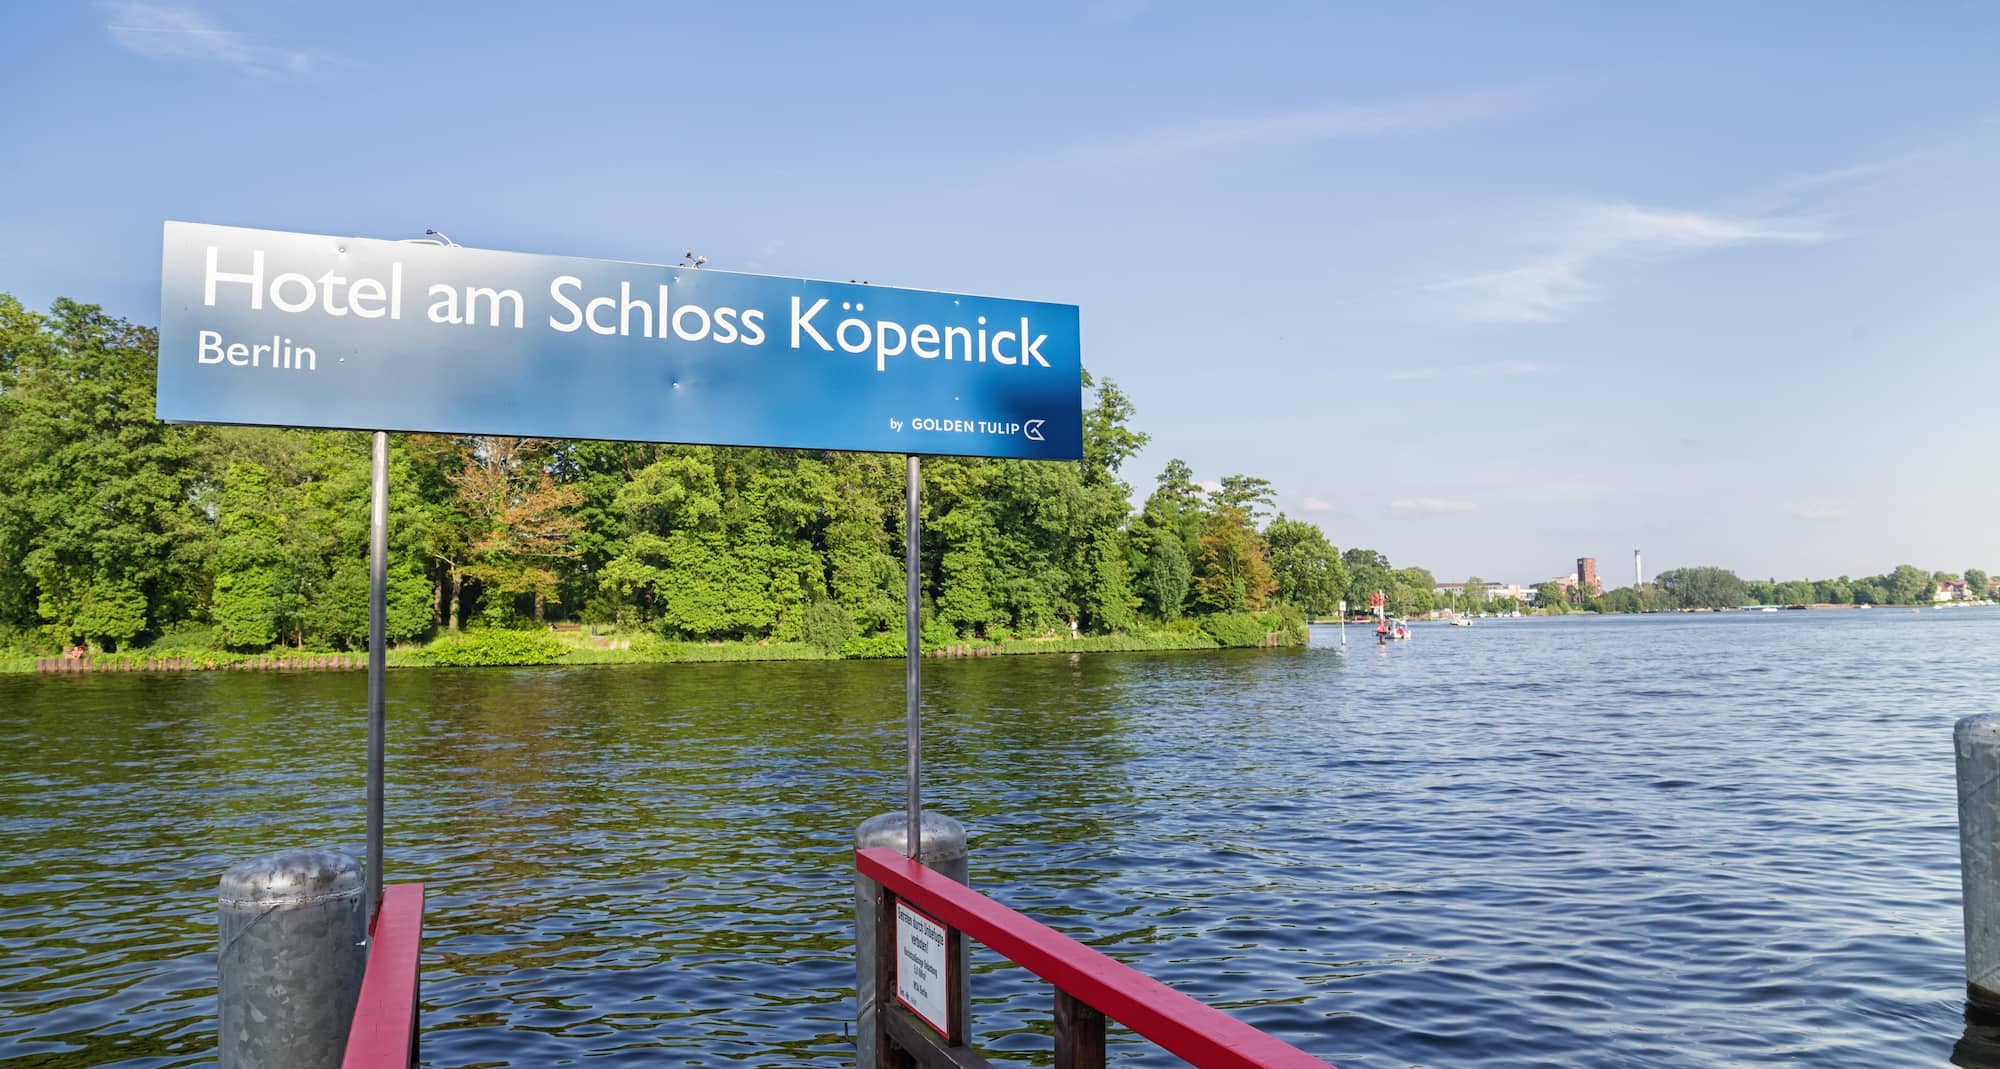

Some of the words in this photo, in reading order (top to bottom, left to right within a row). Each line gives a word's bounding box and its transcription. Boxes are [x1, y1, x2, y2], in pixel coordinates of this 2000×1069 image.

[203, 246, 401, 320] Hotel
[427, 281, 524, 329] am
[549, 275, 765, 347] Schloss
[790, 295, 1051, 372] Köpenick
[197, 330, 316, 370] Berlin
[889, 417, 903, 433] by
[911, 417, 974, 433] GOLDEN
[978, 421, 1020, 435] TULIP
